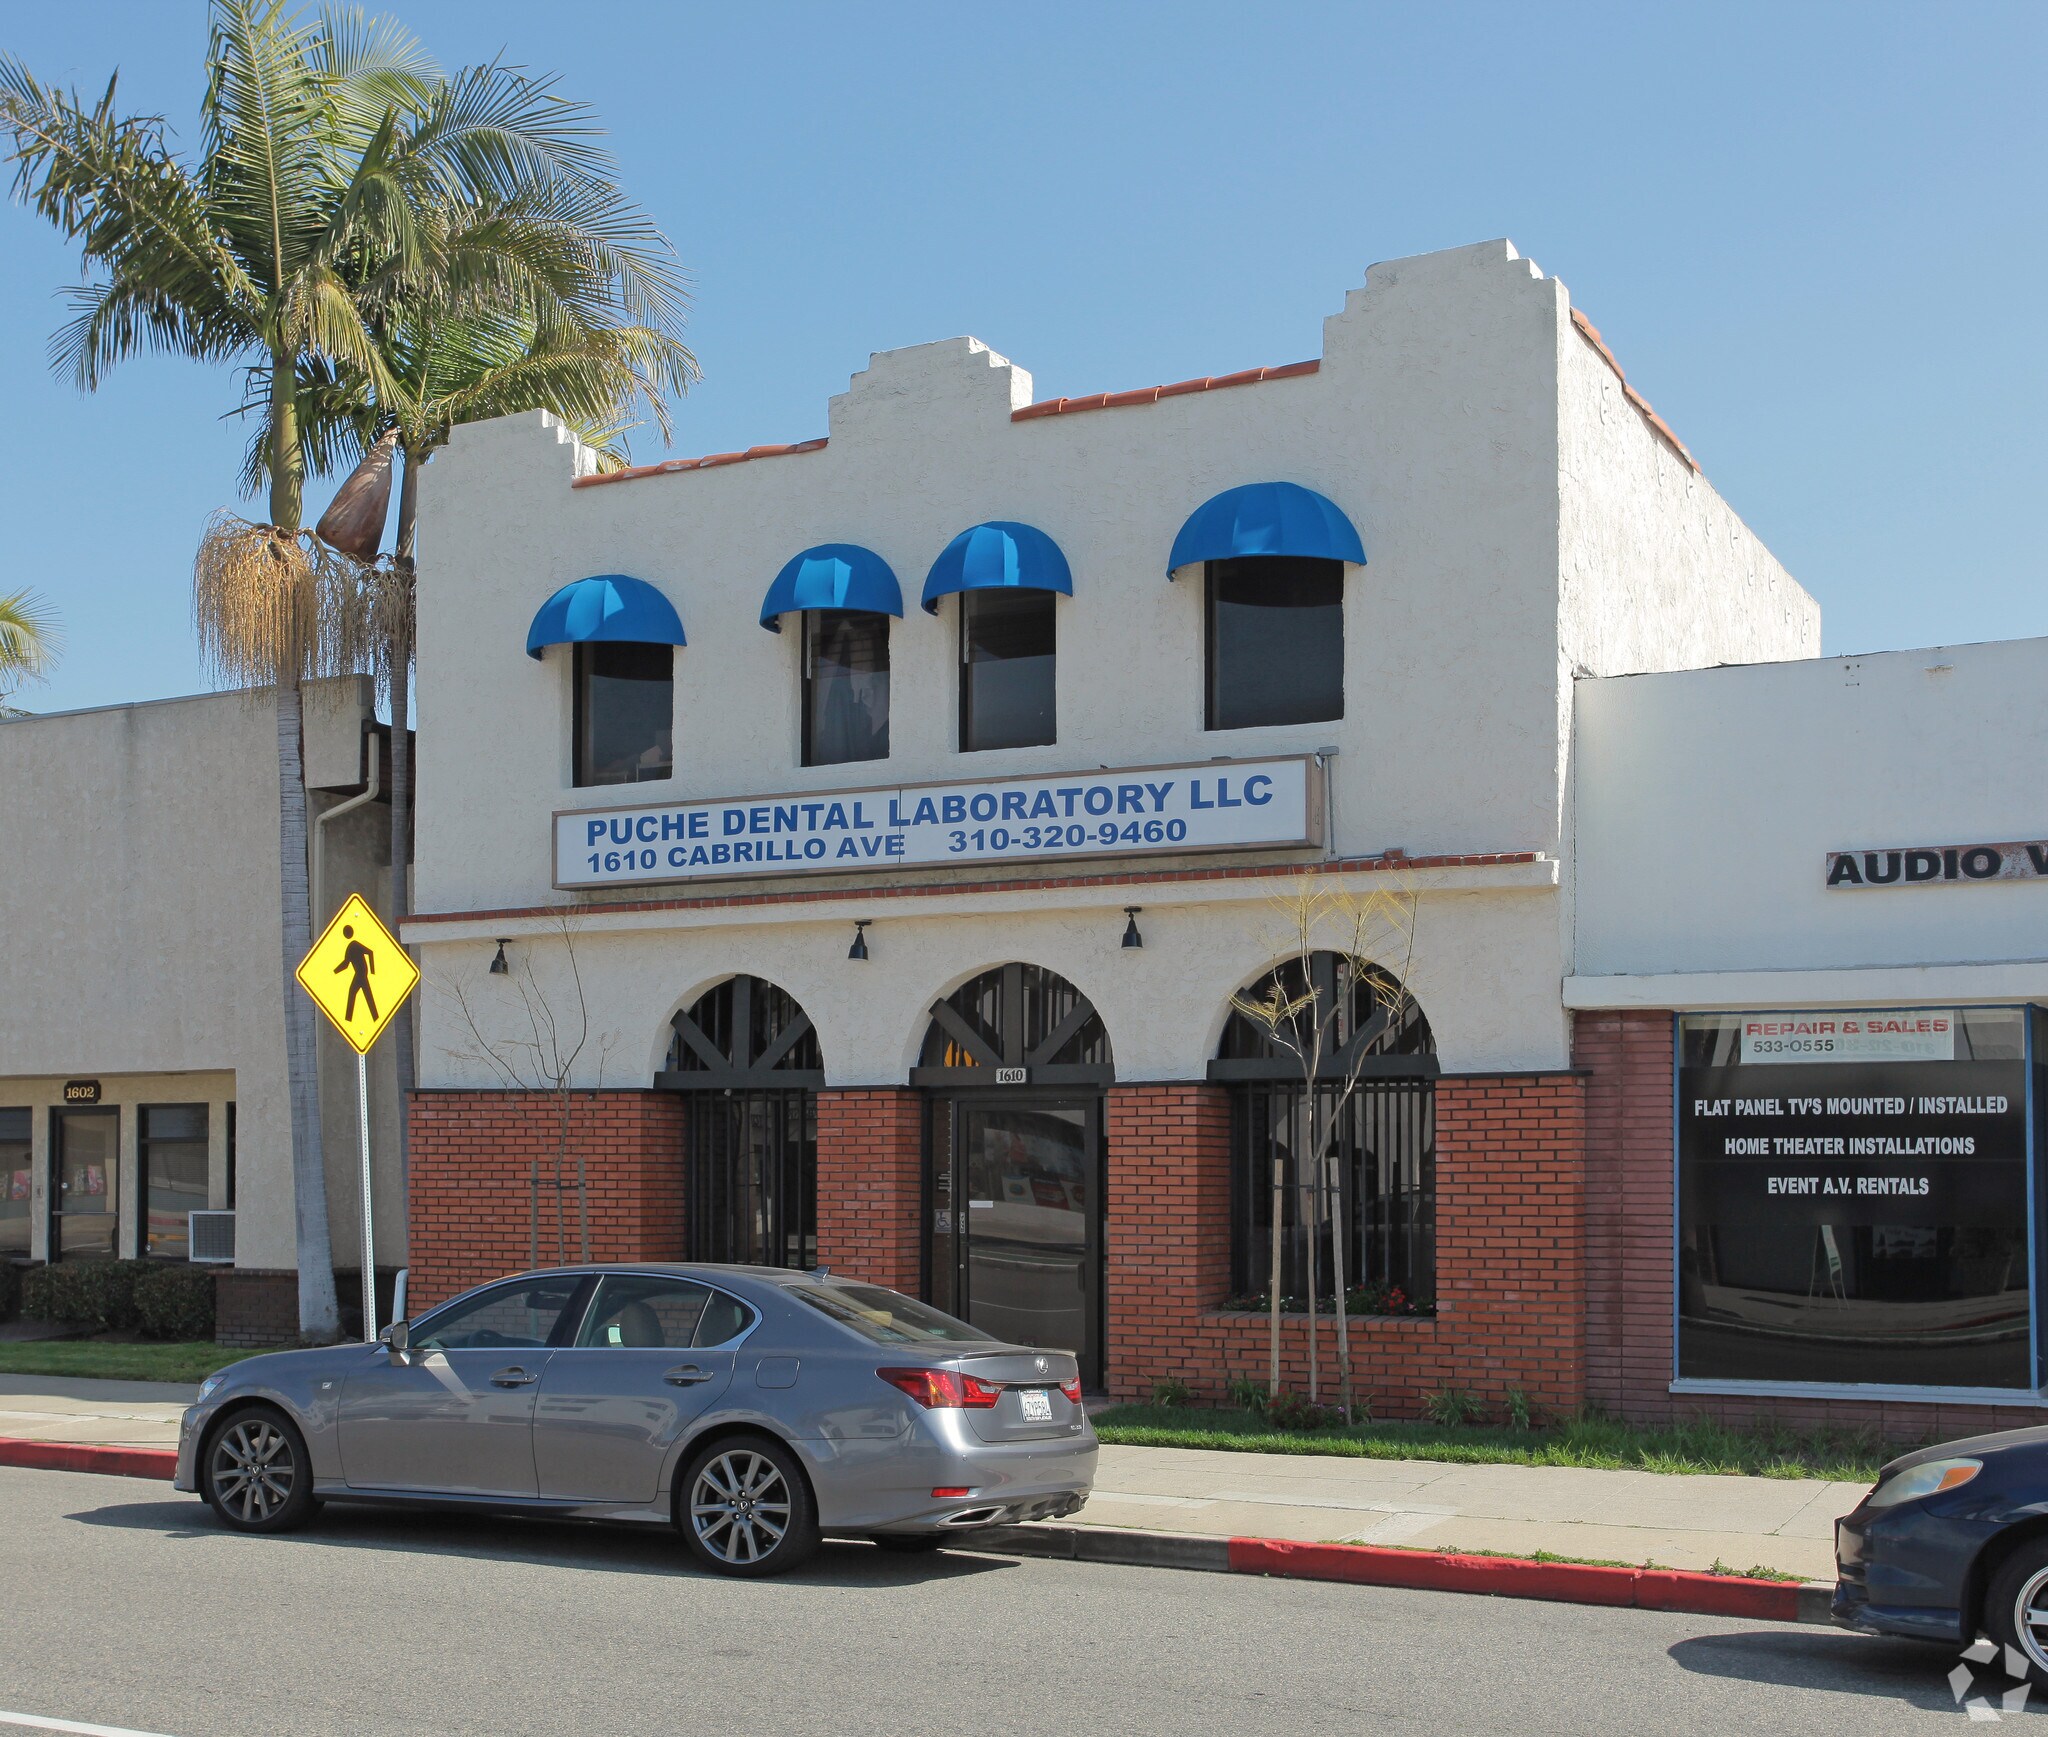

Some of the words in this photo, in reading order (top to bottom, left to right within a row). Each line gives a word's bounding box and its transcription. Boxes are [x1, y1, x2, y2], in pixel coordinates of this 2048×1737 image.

[587, 812, 709, 847] PUCHE
[723, 801, 874, 836] DENTAL
[889, 782, 1175, 827] LABORATORY
[1190, 775, 1273, 810] LLC
[948, 818, 1187, 853] 310-320-9460
[587, 849, 657, 873] 1610
[667, 838, 827, 868] CABRILLO
[836, 834, 906, 859] AVE
[1826, 847, 2003, 885] AUDIO
[1746, 1021, 1836, 1036] REPAIR
[1842, 1021, 1861, 1034] &
[1867, 1019, 1949, 1033] SALES
[1753, 1039, 1834, 1053] 533-0555
[999, 1069, 1023, 1081] 1610
[66, 1086, 95, 1099] 1602
[1694, 1099, 1731, 1116] FLAT
[1735, 1099, 1784, 1116] PANEL
[1788, 1098, 1822, 1116] TV'S
[1826, 1097, 1905, 1115] MOUNTED
[1918, 1096, 2008, 1114] INSTALLED
[1725, 1138, 1770, 1155] HOME
[1773, 1137, 1845, 1155] THEATER
[1849, 1137, 1975, 1155] INSTALLATIONS
[1767, 1177, 1819, 1194] EVENT
[1823, 1177, 1852, 1194] A.V.
[1857, 1177, 1930, 1195] RENTALS
